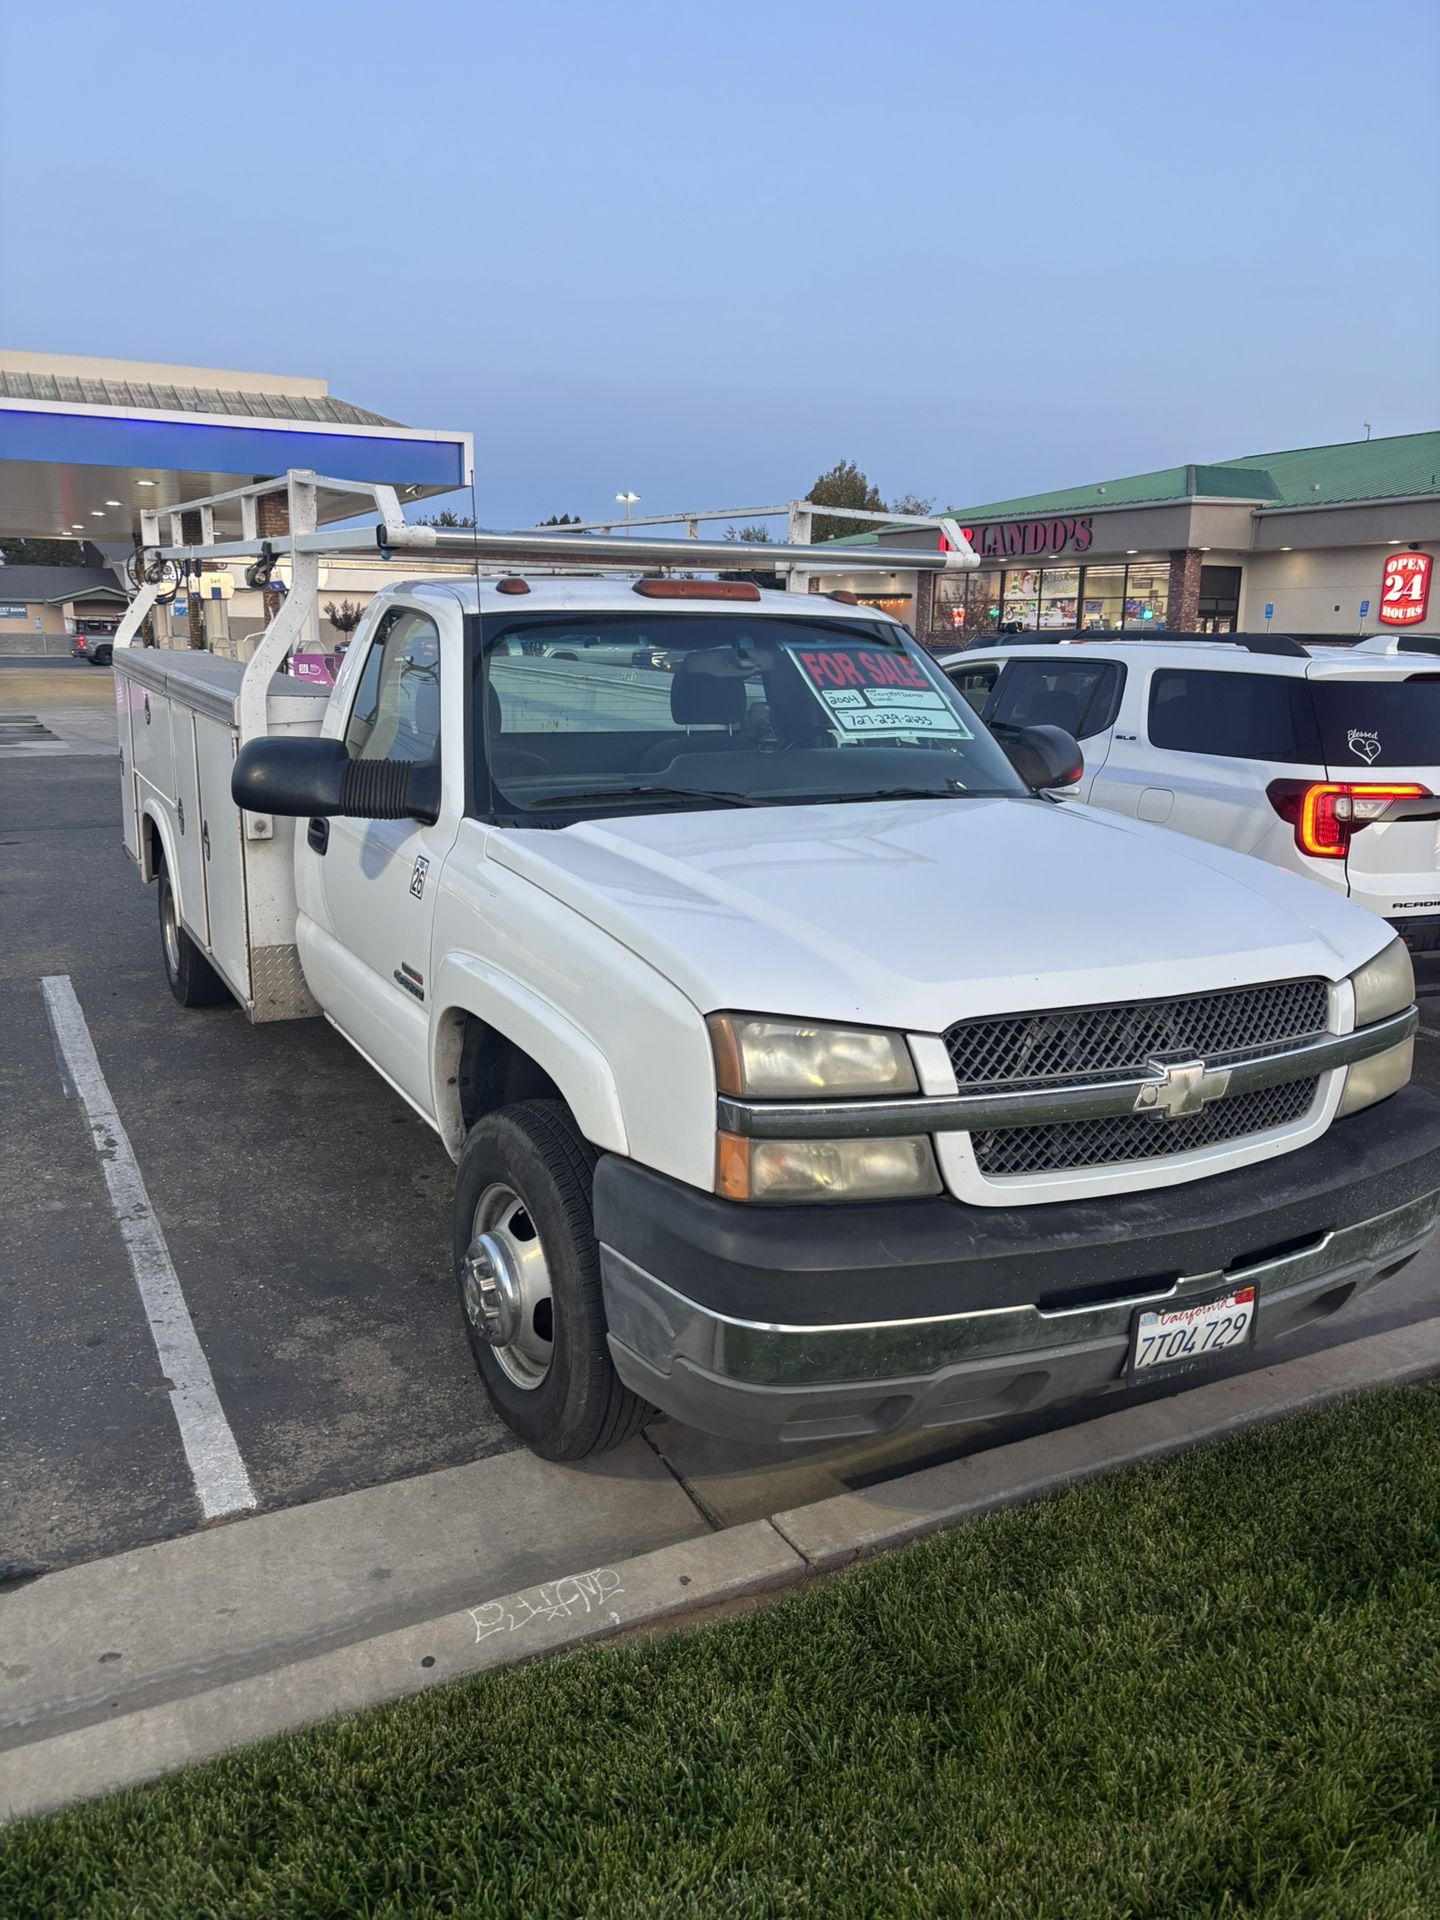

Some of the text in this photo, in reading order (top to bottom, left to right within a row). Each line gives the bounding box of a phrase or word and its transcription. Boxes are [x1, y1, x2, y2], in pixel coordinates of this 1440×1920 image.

[1386, 557, 1427, 573] OPEN
[1383, 574, 1424, 601] 24
[1382, 604, 1423, 619] HOURS
[800, 652, 929, 688] FOR SALE
[829, 695, 860, 705] 2004
[1347, 728, 1379, 741] Blessed
[1137, 1312, 1248, 1366] 7T04729
